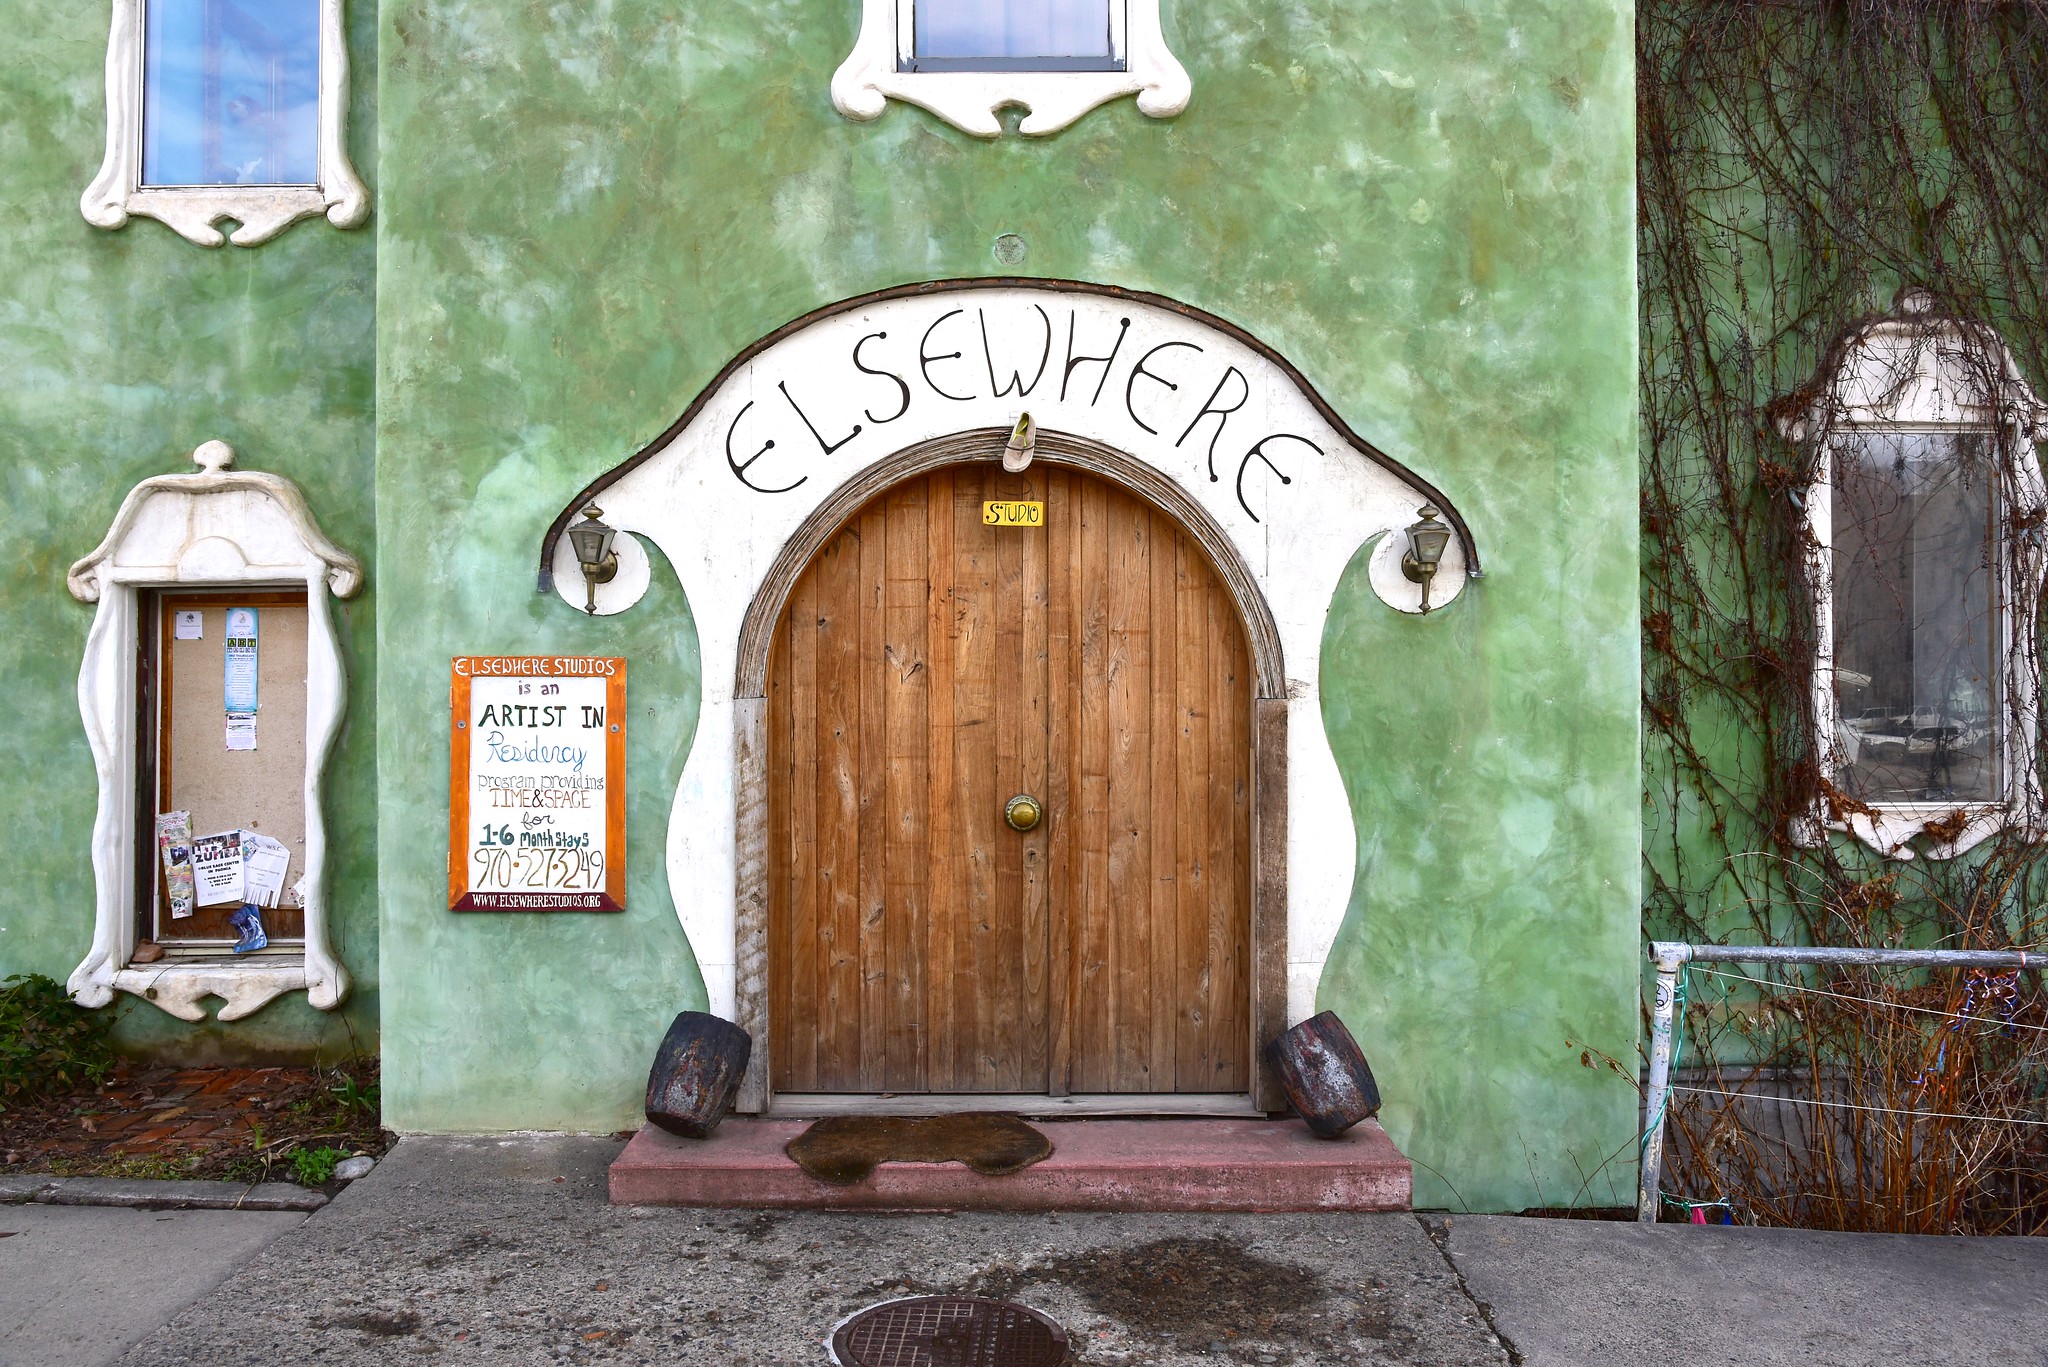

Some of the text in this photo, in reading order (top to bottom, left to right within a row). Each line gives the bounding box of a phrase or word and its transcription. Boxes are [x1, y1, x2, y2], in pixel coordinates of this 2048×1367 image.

[725, 304, 1325, 523] ELSEWHERE
[986, 503, 1039, 523] STUDIO
[228, 638, 256, 647] ART
[455, 658, 615, 676] ELSEWHERE STUDIOS
[518, 680, 560, 695] is an
[478, 704, 604, 728] ARTIST IN
[486, 731, 587, 772] Residency
[478, 771, 604, 792] program providing
[520, 811, 555, 830] for
[479, 824, 515, 845] 1-6
[195, 847, 241, 863] ZUMBA
[472, 894, 600, 908] WWW.ELSEWHERESTUDIOS.ORG
